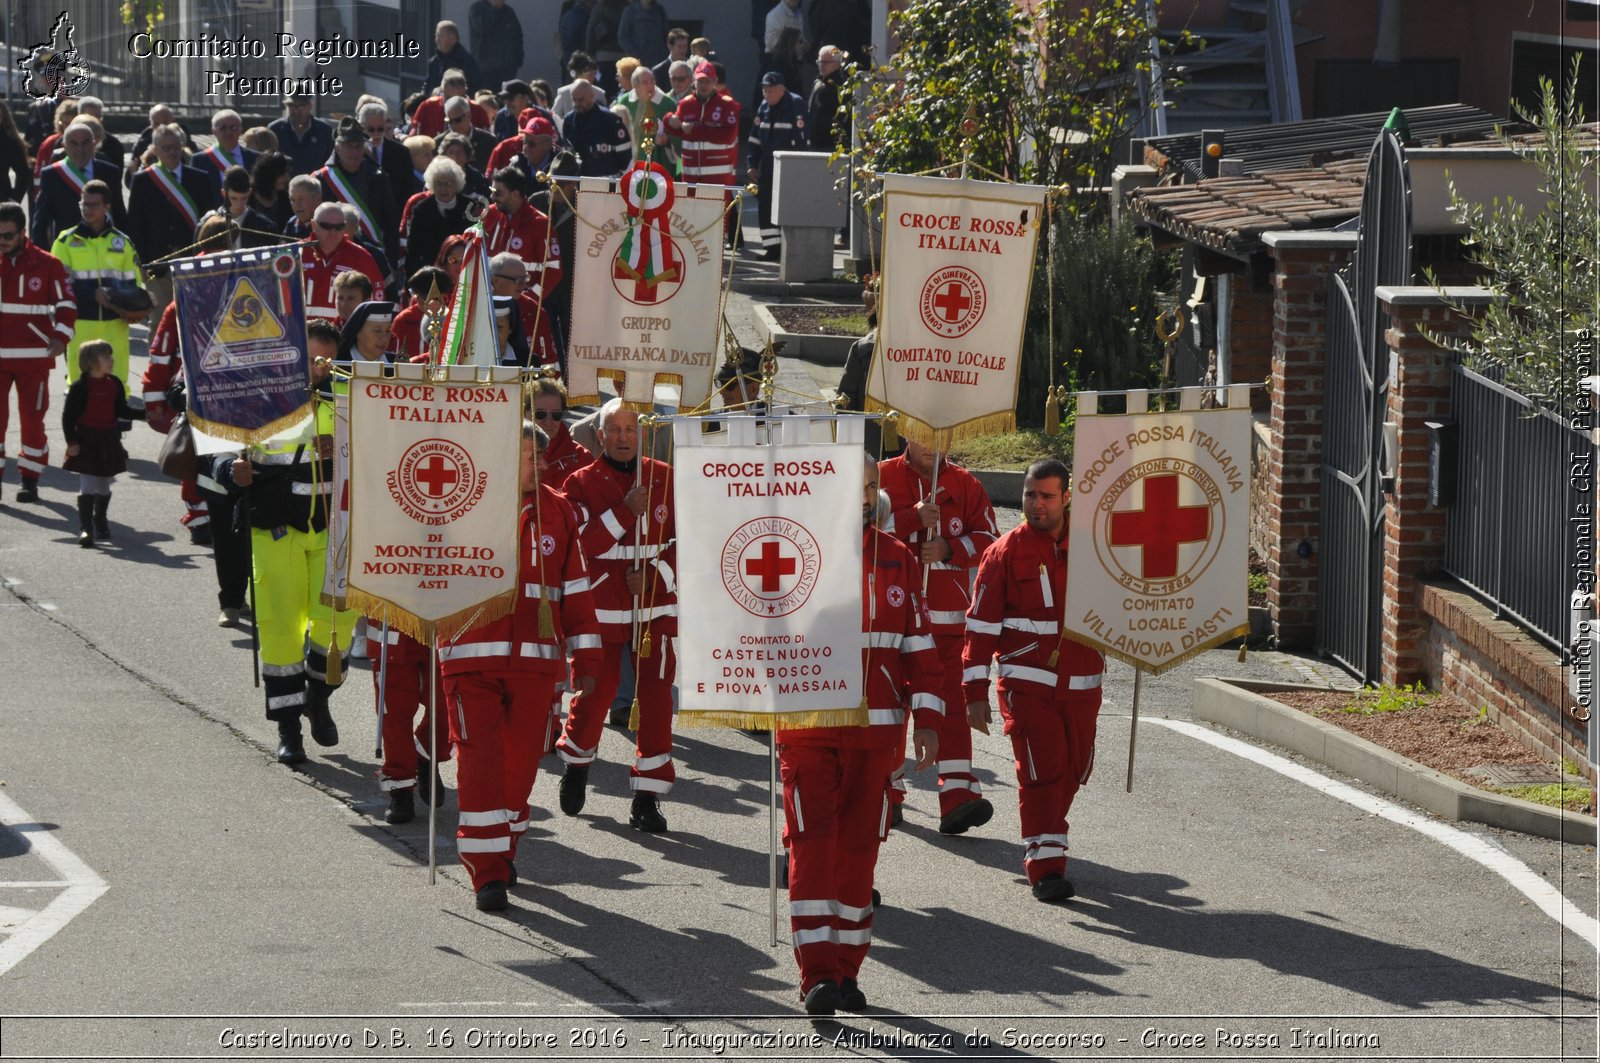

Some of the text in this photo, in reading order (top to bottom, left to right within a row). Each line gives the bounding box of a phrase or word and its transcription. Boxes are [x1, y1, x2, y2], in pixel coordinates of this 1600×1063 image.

[900, 213, 1024, 237] CROCE ROSSA
[918, 234, 1002, 254] ITALIANA
[933, 276, 942, 284] DI
[942, 271, 971, 282] GINEVRA
[970, 280, 978, 289] 22
[924, 283, 942, 330] CONVENZIONE
[971, 290, 981, 319] AGOSTO
[621, 317, 671, 330] GRUPPO
[640, 333, 651, 343] DI
[256, 352, 292, 360] SECURITY
[573, 345, 712, 366] VILLAFRANCA D'ASTI
[887, 348, 1006, 370] COMITATO LOCALE
[907, 368, 979, 385] DI CANELLI
[366, 384, 508, 402] CROCE ROSSA
[389, 406, 484, 423] ITALIANA
[1078, 426, 1244, 494] CROCE ROSSA ITALIANA
[403, 444, 470, 507] CONVENZIONE DI GINEVRA 22 AGOSTO 1864
[703, 460, 835, 477] CROCE ROSSA
[728, 481, 811, 497] ITALIANA
[1100, 460, 1221, 511] CONVENZIONE DI GINEVRA
[386, 470, 488, 526] VOLONTARI DEL SOCCORSO
[428, 534, 443, 542] DI
[375, 545, 494, 560] MONTIGLIO
[363, 562, 504, 578] MONFERRATO
[724, 520, 816, 612] CONVENZIONE DI GINEVRA 22 AGOSTO 1864
[418, 580, 448, 589] ASTI
[1123, 597, 1194, 611] COMITATO
[1083, 608, 1232, 657] VILLANOVA D'ASTI
[1129, 618, 1187, 631] LOCALE
[740, 635, 804, 645] COMITATO DI
[712, 646, 832, 660] CASTELNUOVO
[723, 664, 821, 678] DON BOSCO
[697, 683, 704, 692] E
[779, 680, 847, 694] MASSAIA
